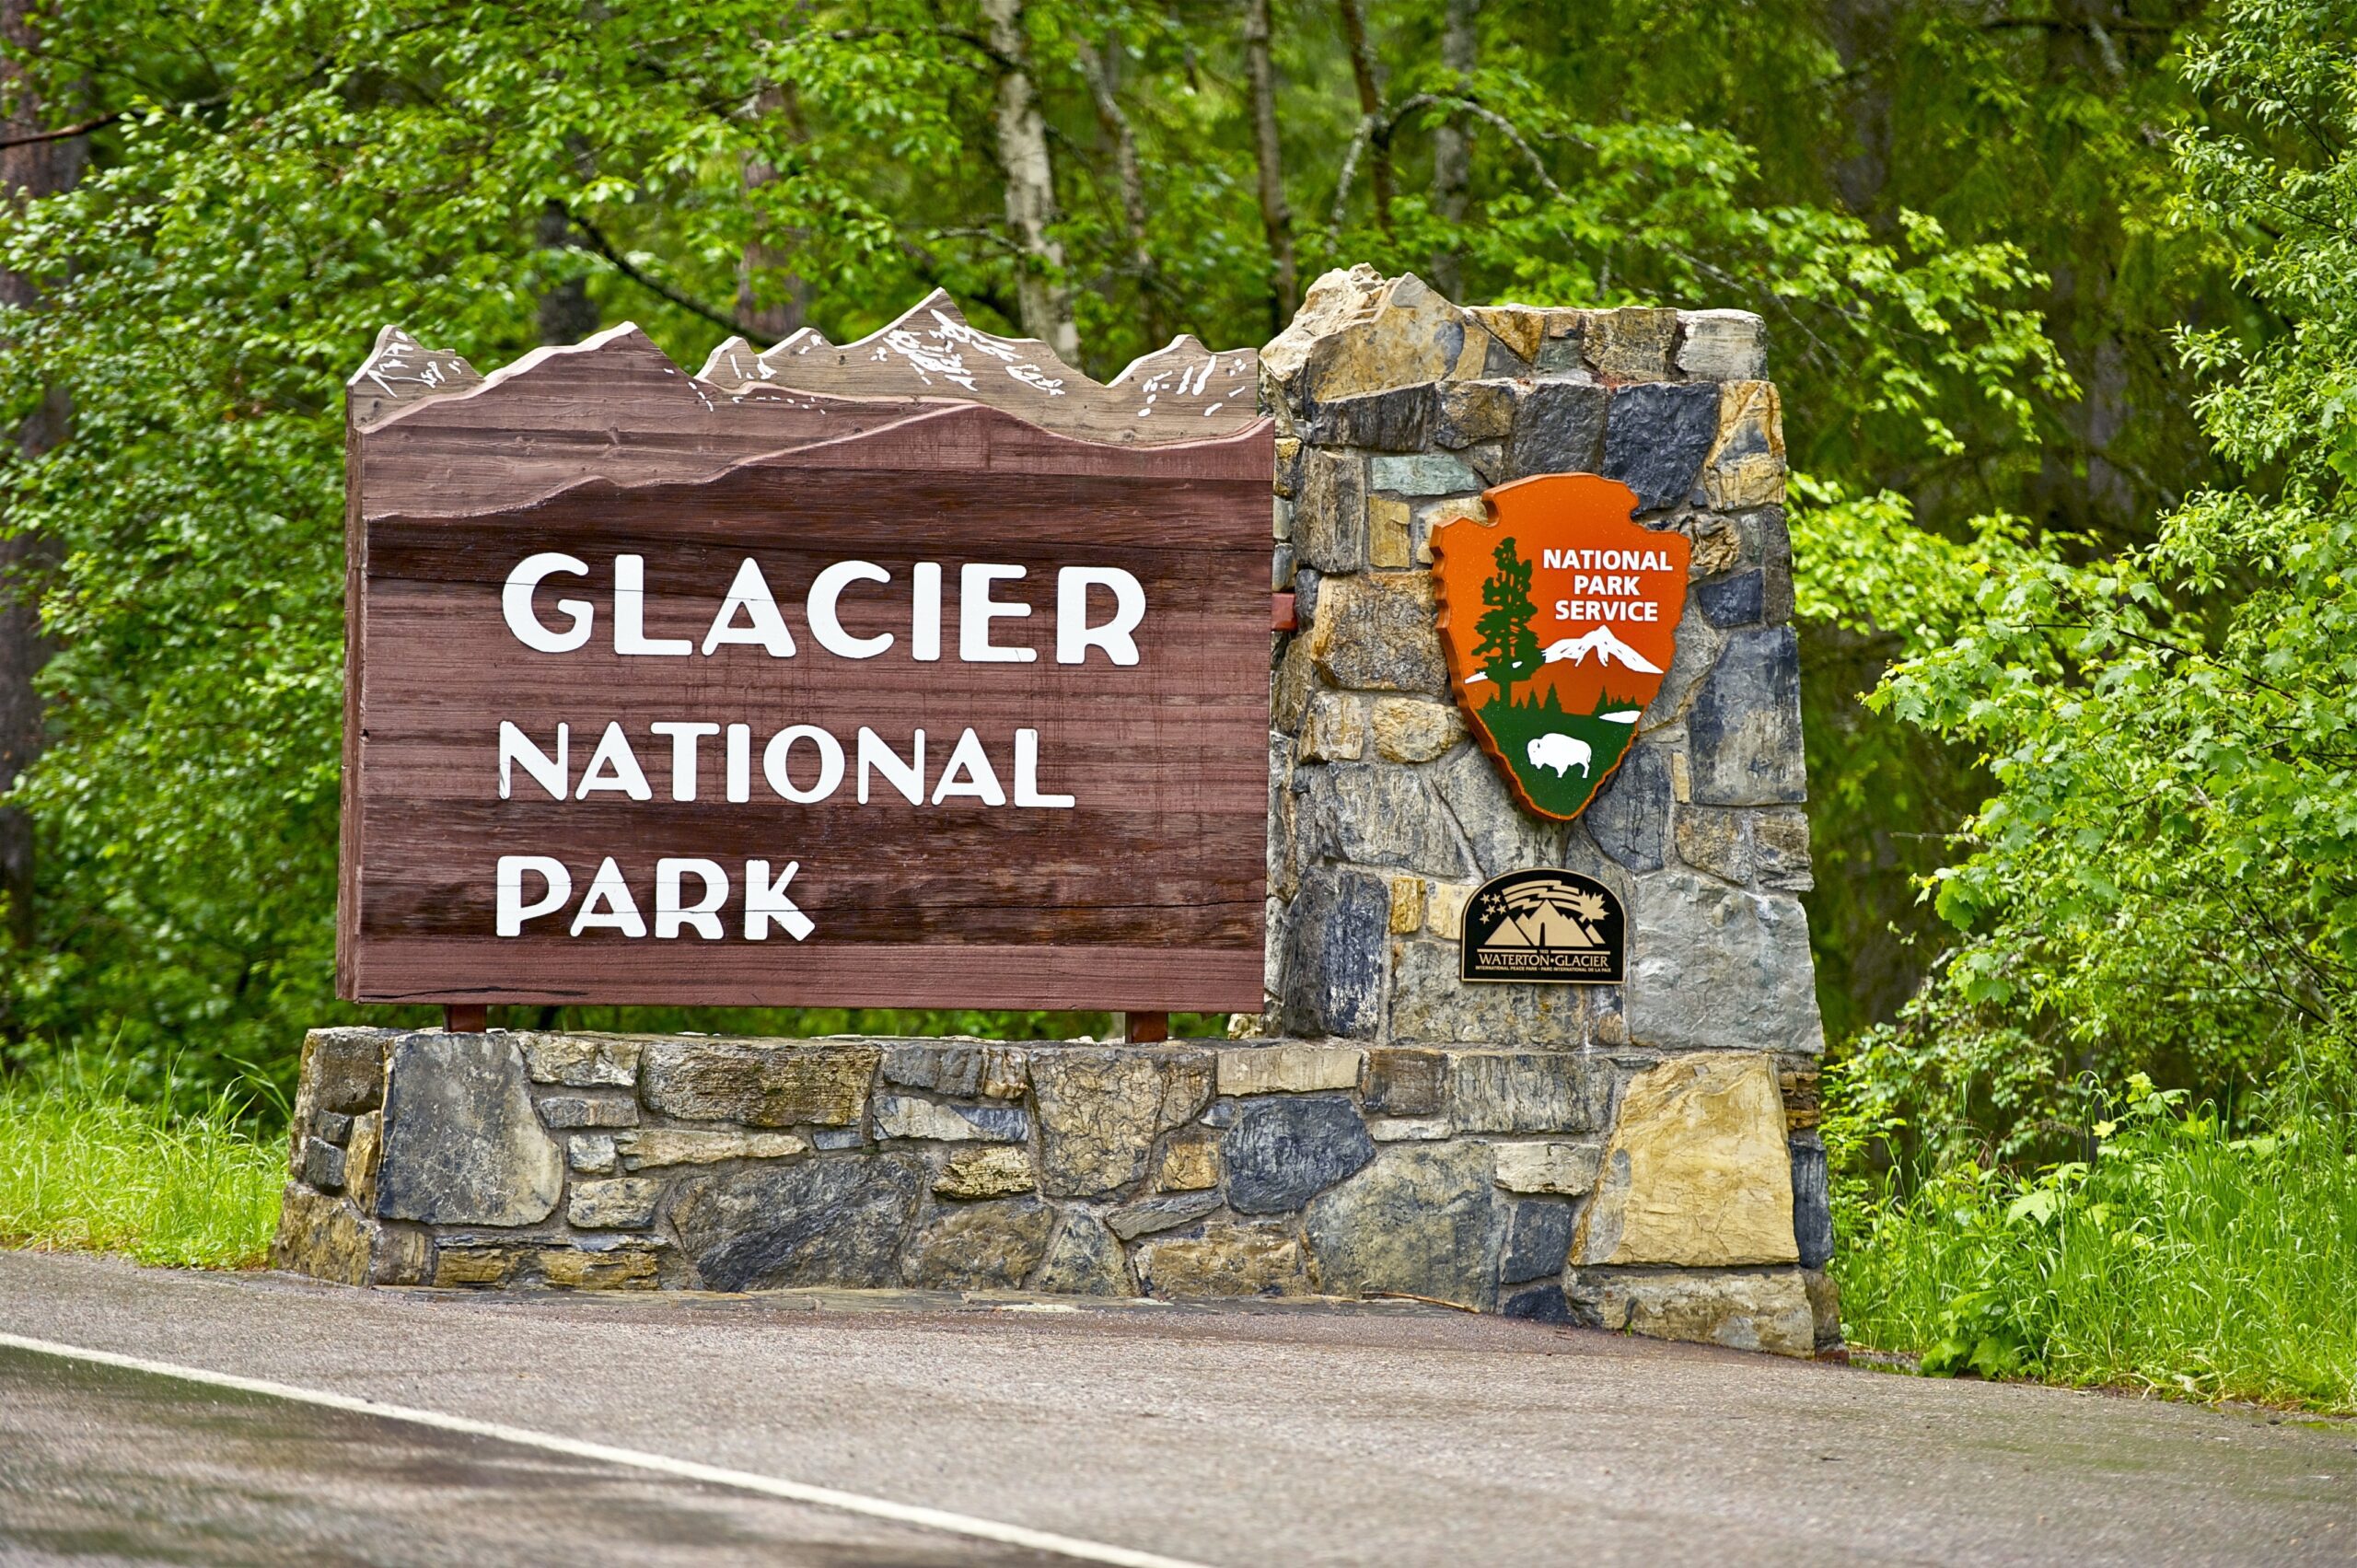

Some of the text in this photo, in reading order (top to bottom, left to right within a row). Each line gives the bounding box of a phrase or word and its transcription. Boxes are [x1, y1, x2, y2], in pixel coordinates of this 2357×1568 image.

[1543, 549, 1673, 571] NATIONAL
[1574, 575, 1641, 596] PARK
[502, 552, 1146, 666] GLACIER
[1555, 600, 1658, 621] SERVICE
[498, 720, 1075, 809] NATIONAL
[496, 855, 816, 941] PARK
